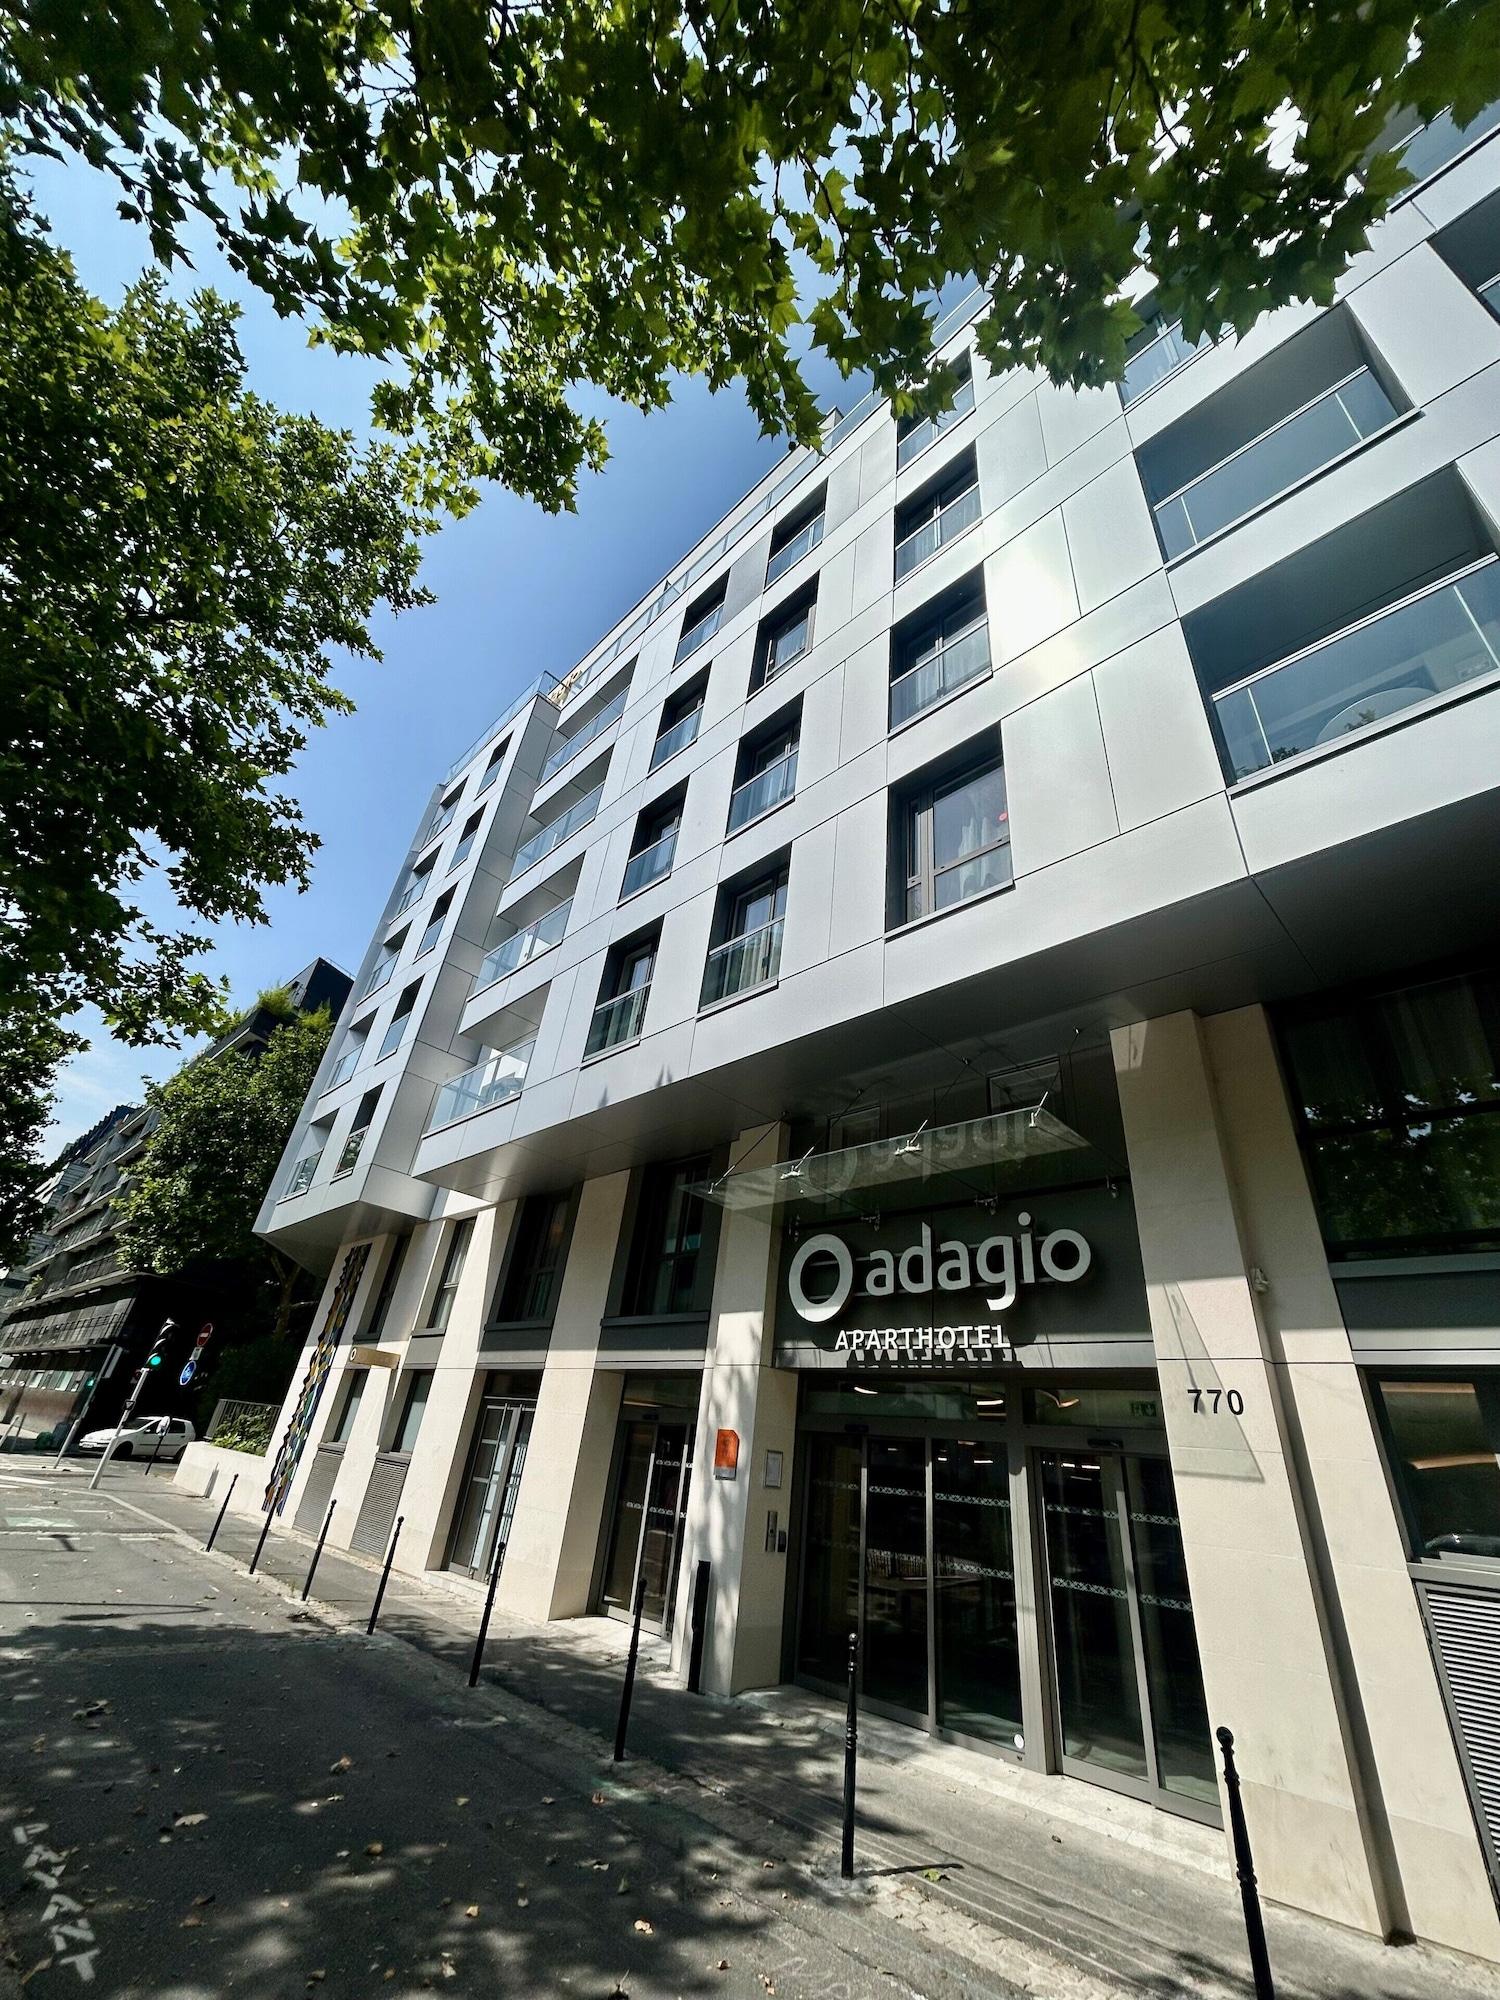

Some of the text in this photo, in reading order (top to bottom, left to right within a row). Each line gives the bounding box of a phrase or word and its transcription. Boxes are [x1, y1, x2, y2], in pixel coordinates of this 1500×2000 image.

[865, 1211, 1092, 1312] adagio
[834, 1324, 1011, 1351] APARTHOTEL
[1187, 1388, 1245, 1416] 770
